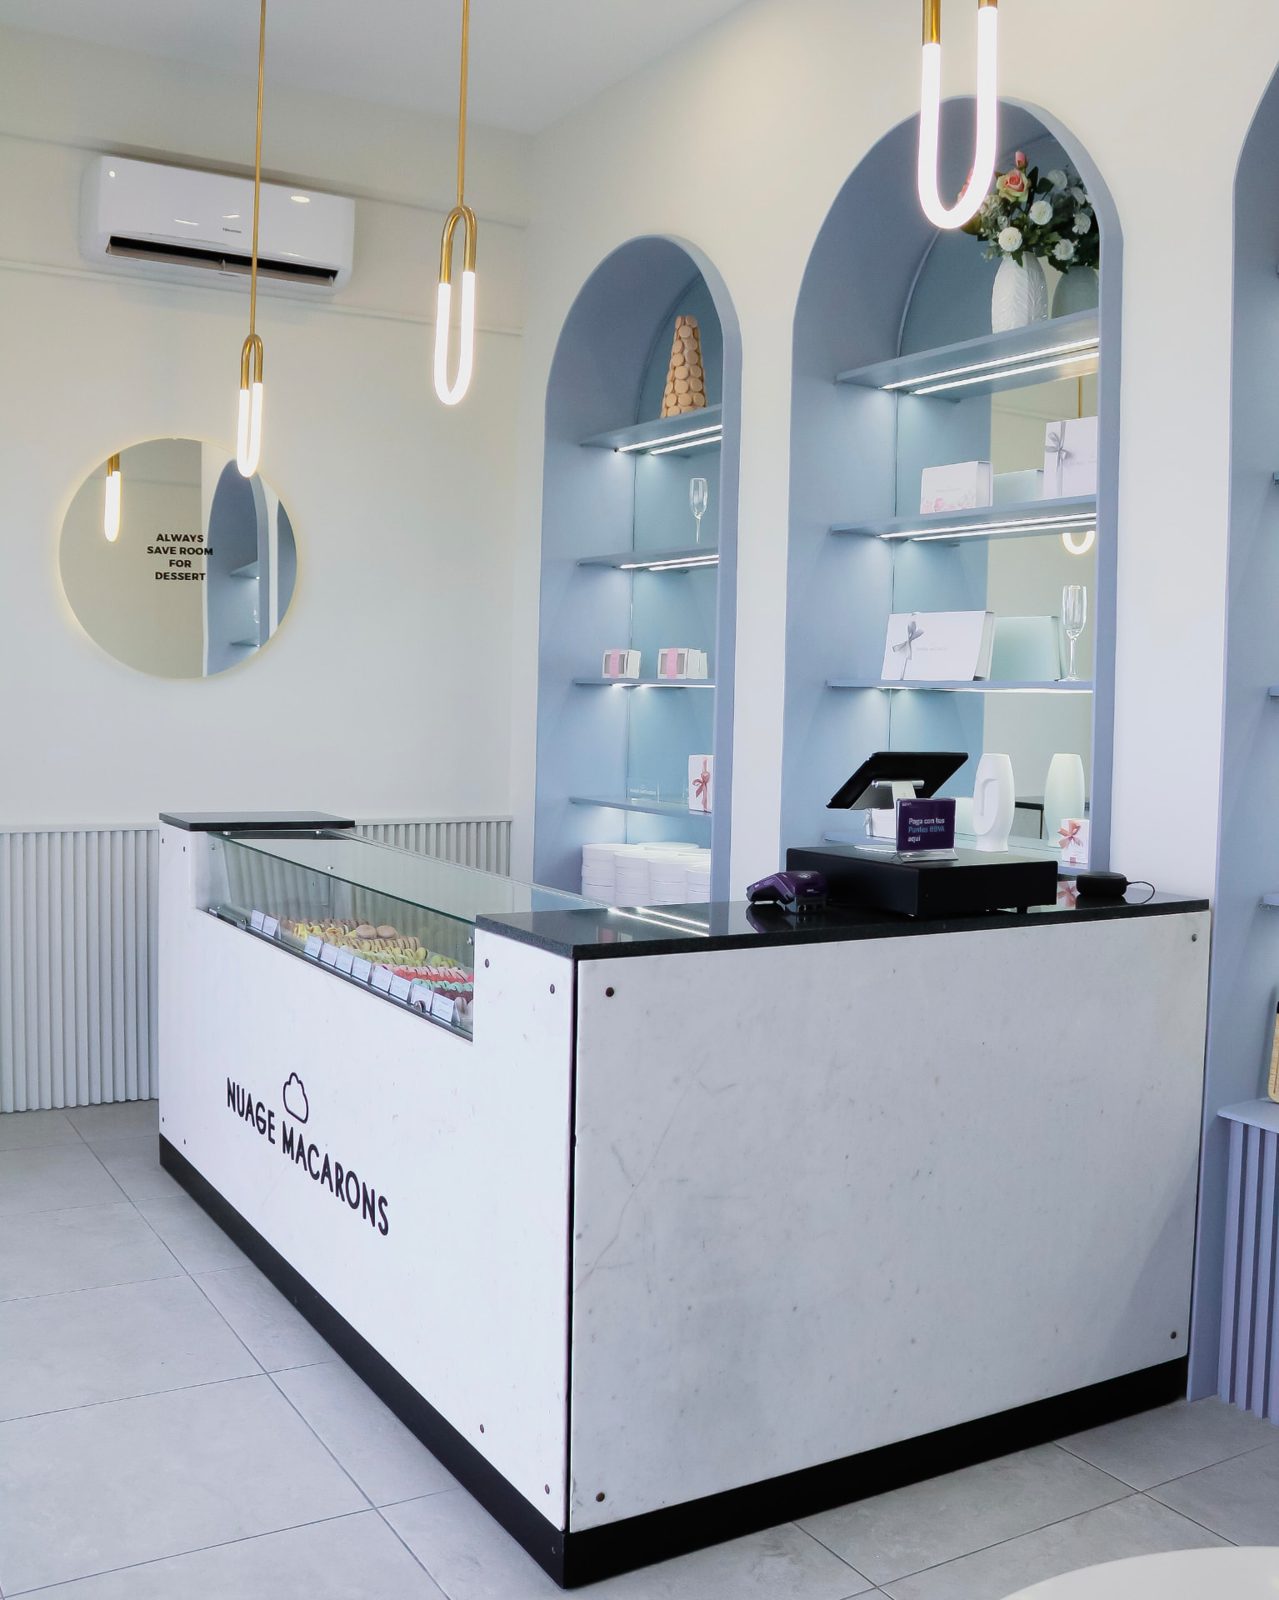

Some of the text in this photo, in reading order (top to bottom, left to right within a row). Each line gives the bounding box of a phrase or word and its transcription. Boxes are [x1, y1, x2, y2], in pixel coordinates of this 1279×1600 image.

[156, 533, 204, 543] ALWAYS
[146, 546, 214, 555] SAVE ROOM
[169, 559, 192, 568] FOR
[155, 571, 206, 581] DESSERT
[227, 1077, 389, 1236] NUAGE MACARONS
